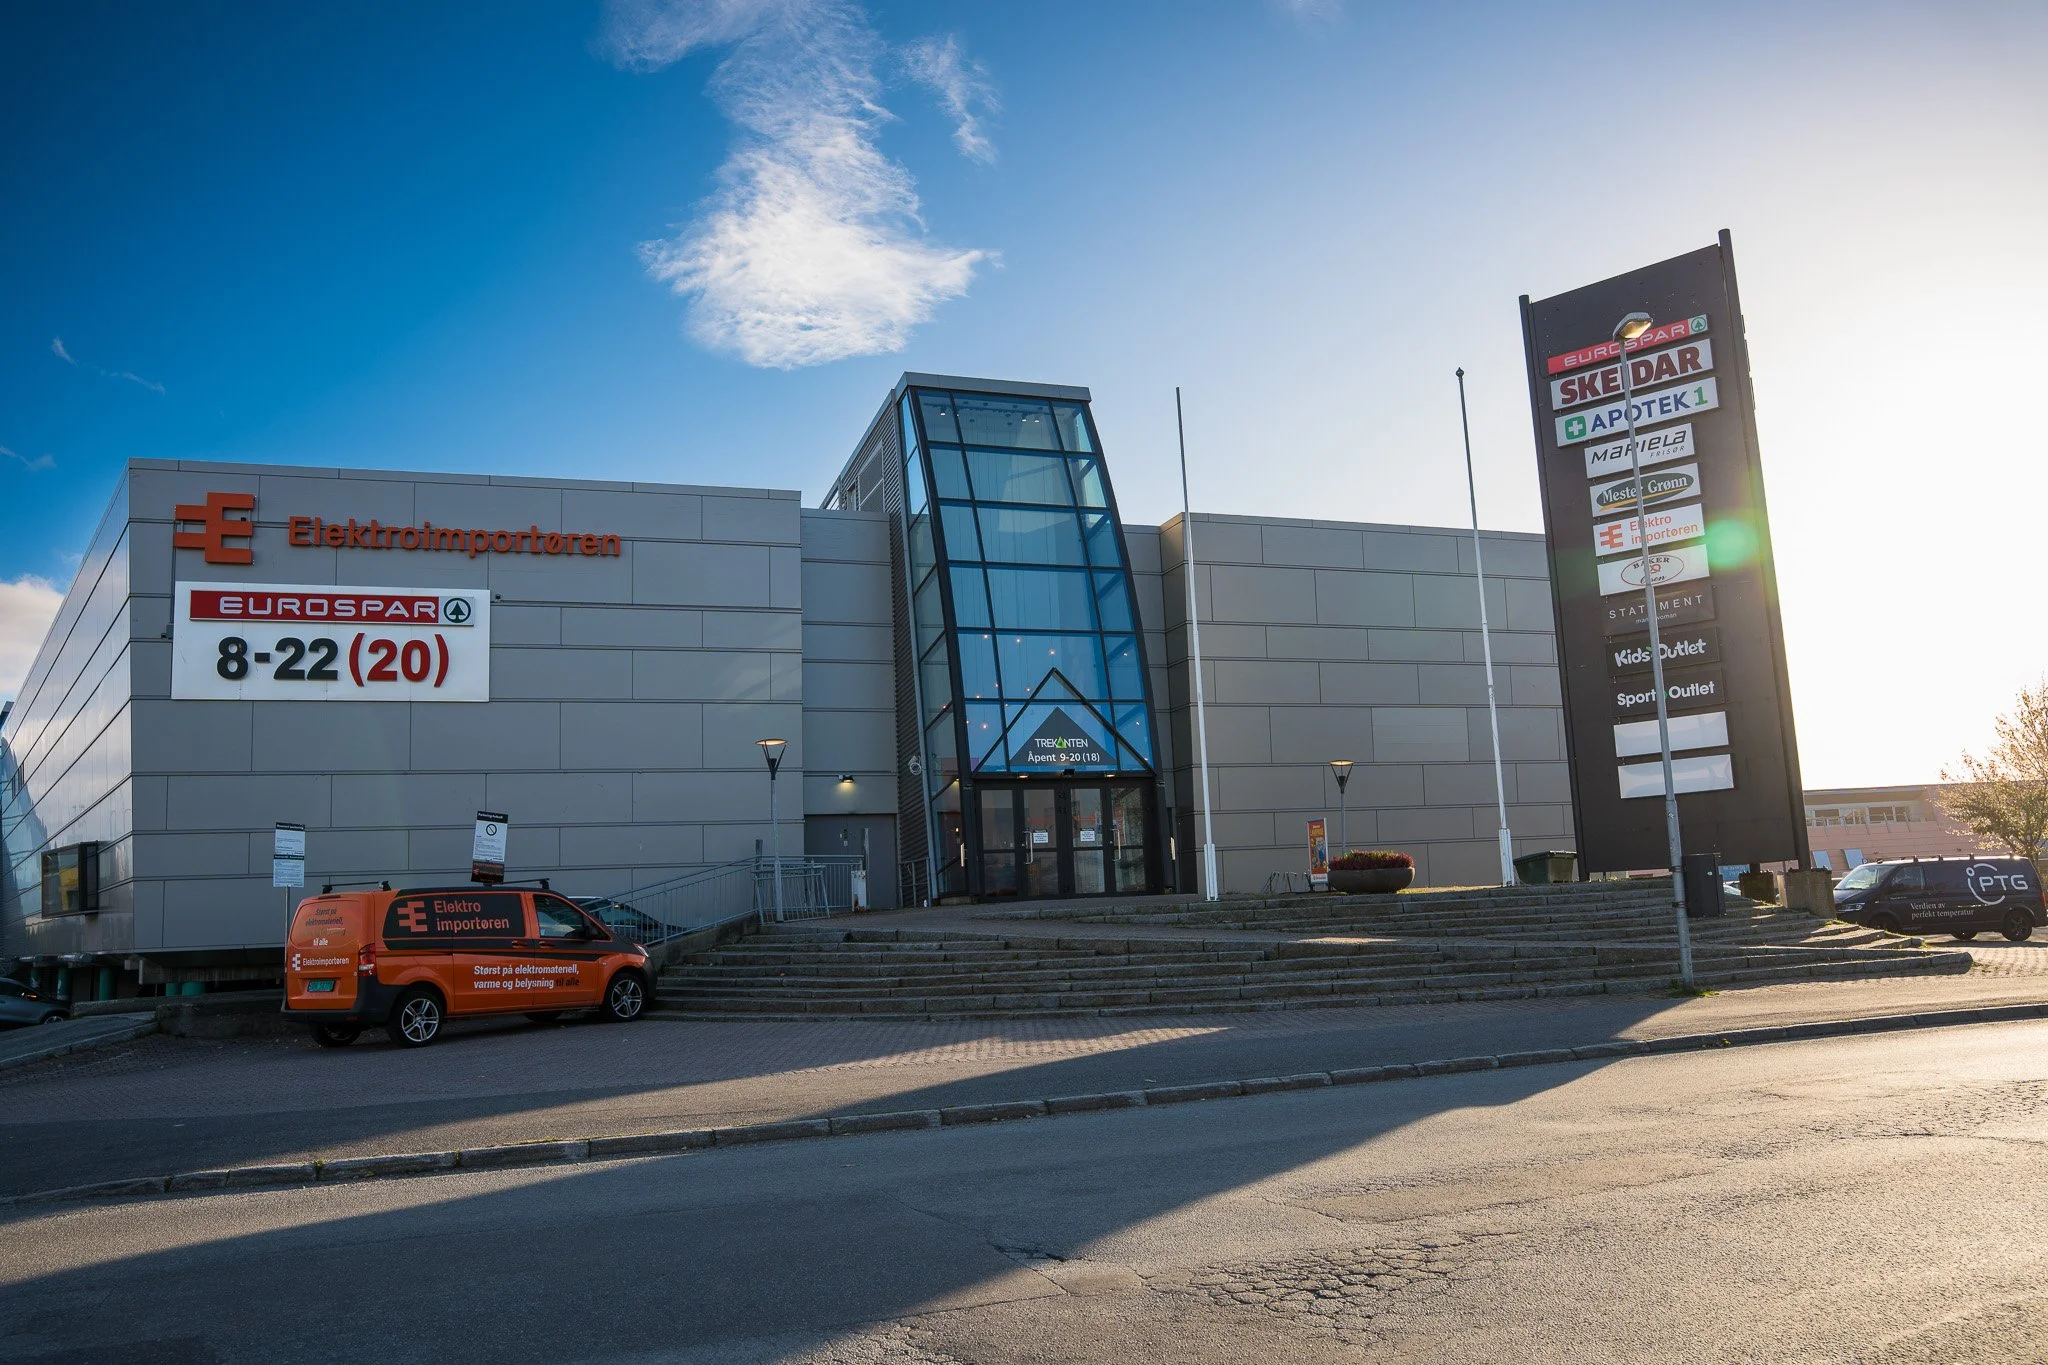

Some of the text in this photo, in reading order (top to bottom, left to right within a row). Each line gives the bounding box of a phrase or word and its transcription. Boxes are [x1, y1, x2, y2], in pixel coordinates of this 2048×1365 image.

[1563, 323, 1686, 368] EUROSPAR
[1590, 385, 1709, 433] APOTEK 1
[1649, 445, 1686, 459] FRISØR
[1647, 476, 1689, 494] Grønn
[288, 515, 622, 559] Elektroimportøren
[218, 595, 437, 619] EUROSPAR
[1609, 594, 1703, 619] STATMENT
[1614, 647, 1651, 668] Kids
[1617, 680, 1715, 708] Sport Outlet
[1027, 750, 1100, 764] Åpent 9-20 (18)
[1978, 874, 2029, 892] PTG
[433, 900, 481, 914] Elektro
[1911, 909, 1975, 920] perfekt temperatur
[436, 916, 510, 934] importøren
[302, 957, 350, 967] Elektroimportøren
[473, 965, 501, 976] Størst
[502, 964, 513, 977] på
[473, 980, 501, 989] varme
[502, 980, 513, 990] og
[514, 977, 554, 990] belysning
